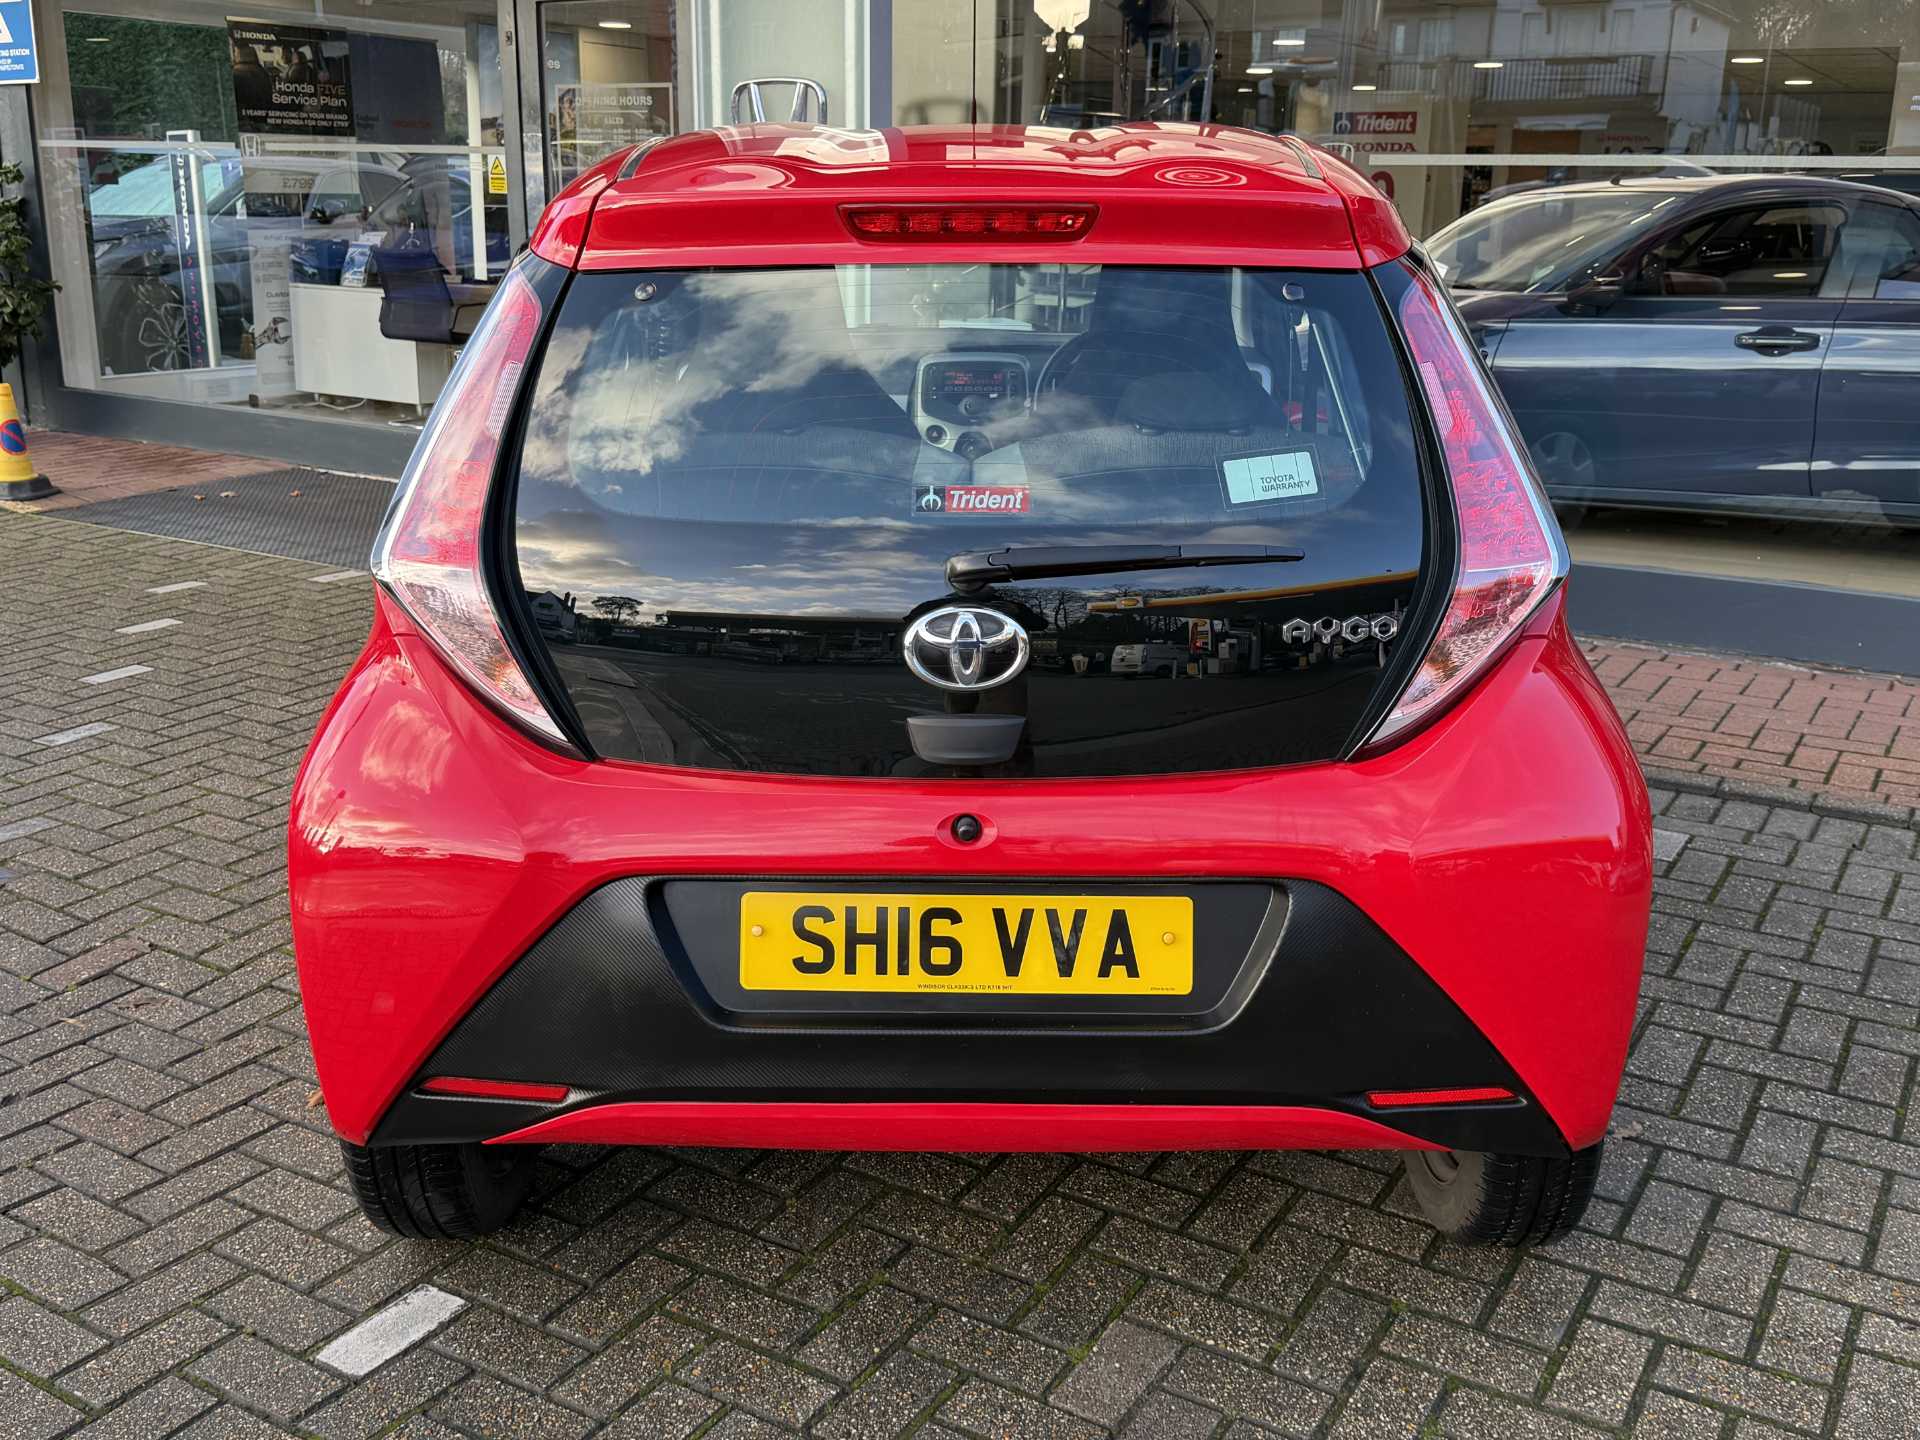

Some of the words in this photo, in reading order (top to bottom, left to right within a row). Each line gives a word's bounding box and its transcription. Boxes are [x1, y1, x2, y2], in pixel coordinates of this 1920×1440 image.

[242, 31, 276, 41] HONDA
[275, 80, 315, 94] Honda
[318, 84, 346, 95] FIVE
[272, 92, 318, 105] Service
[320, 95, 347, 107] Plan
[620, 95, 653, 106] HOURS
[1356, 114, 1414, 132] Trident
[178, 167, 191, 251] HONDA
[1260, 473, 1295, 485] TOYOTA
[1261, 480, 1311, 493] WARRANTY
[950, 490, 1023, 509] Trident
[1282, 615, 1400, 645] AYGO
[791, 904, 963, 977] SH16
[992, 907, 1141, 979] VVA
